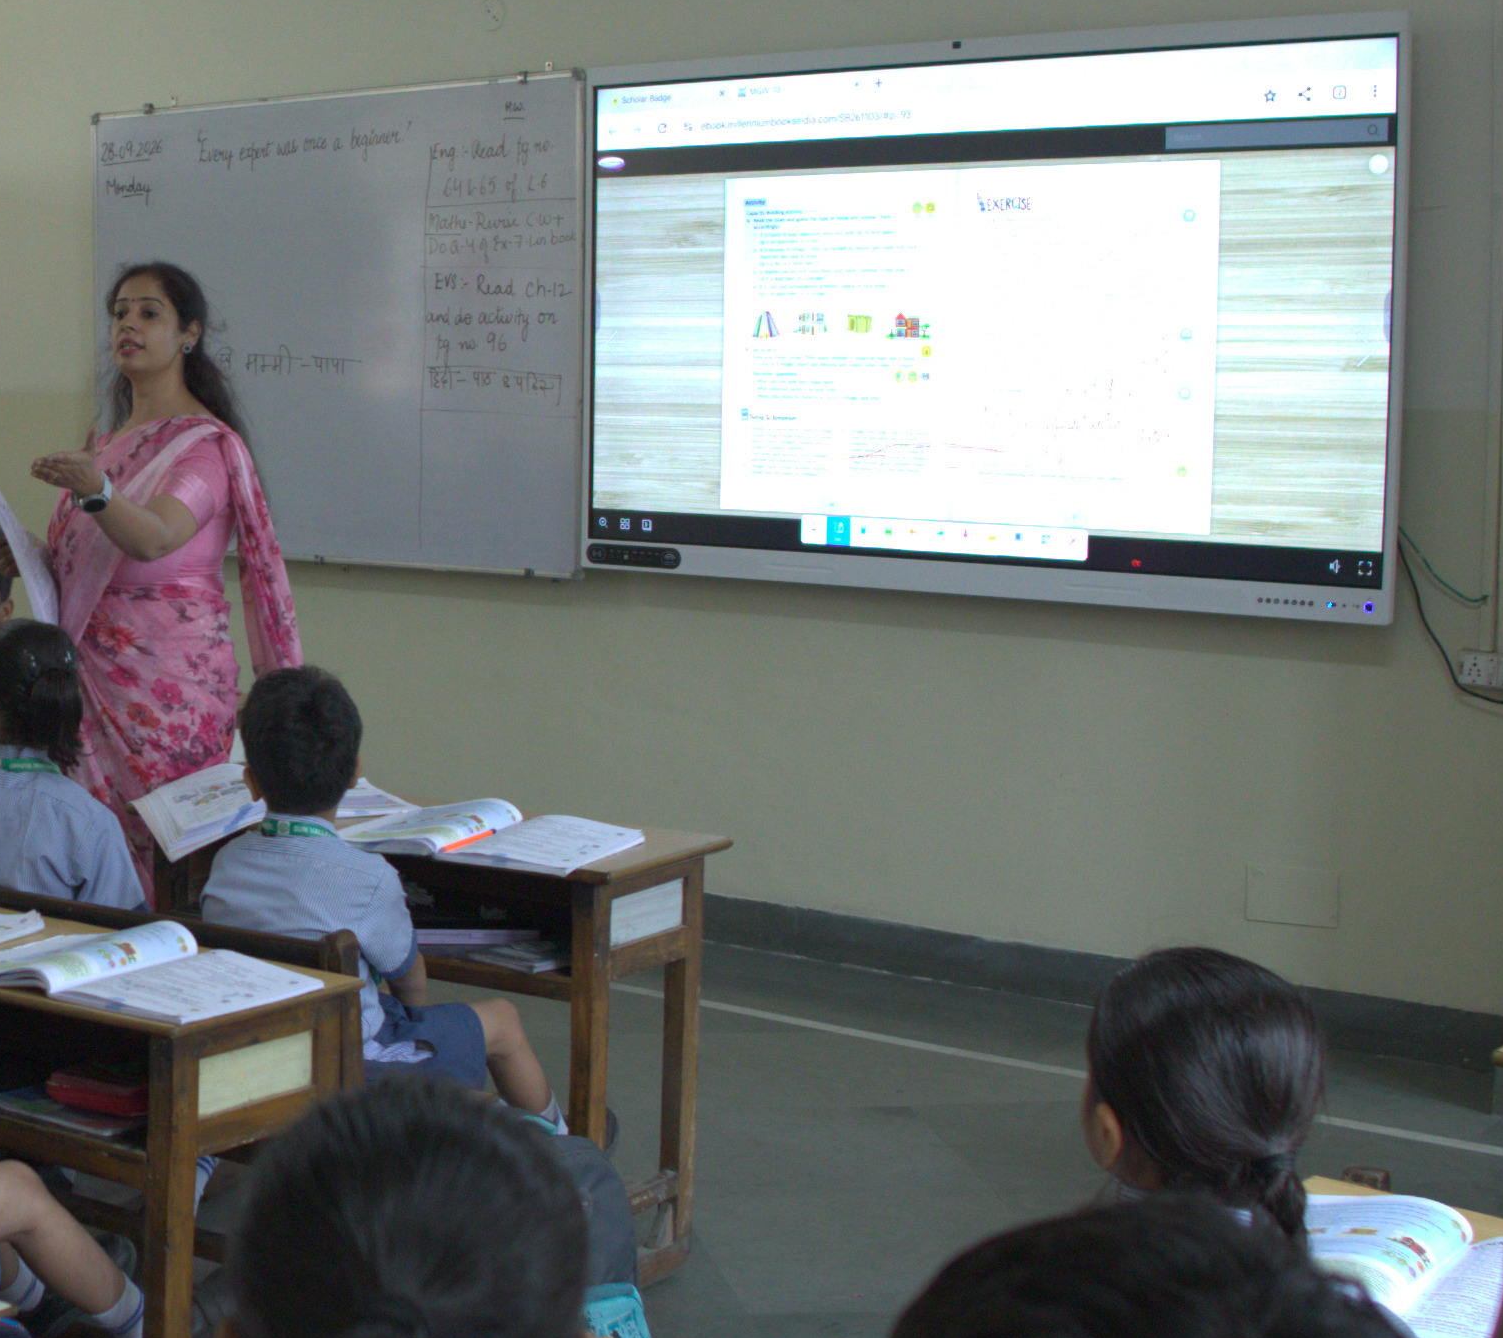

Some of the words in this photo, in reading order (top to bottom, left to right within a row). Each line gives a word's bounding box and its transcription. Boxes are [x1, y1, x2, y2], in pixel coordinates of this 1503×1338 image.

[621, 94, 648, 105] Scholar
[649, 92, 672, 104] Badge
[239, 142, 272, 170] expert
[276, 143, 298, 156] was
[302, 137, 328, 153] once
[333, 138, 343, 152] a
[471, 133, 507, 159] Read
[106, 177, 151, 207] Monday
[444, 176, 462, 197] 64
[506, 172, 518, 204] of
[986, 196, 1032, 212] EXERCISE
[477, 273, 514, 296] Read
[425, 307, 450, 326] and
[454, 307, 472, 326] do
[478, 306, 529, 342] activity
[538, 312, 558, 326] on
[487, 331, 507, 352] 96
